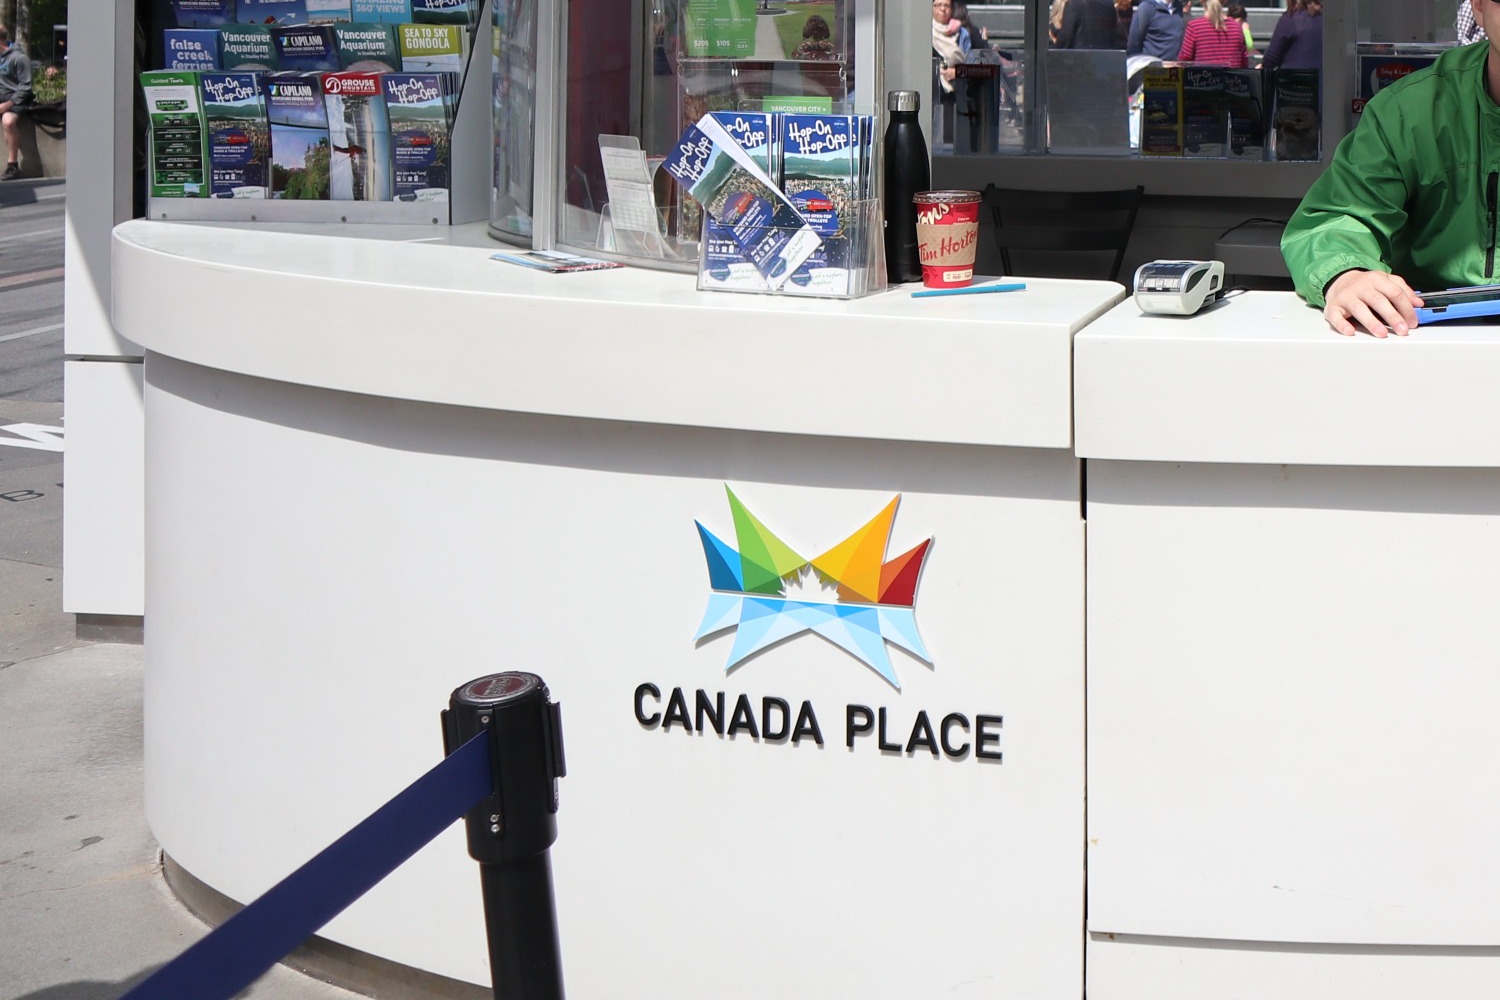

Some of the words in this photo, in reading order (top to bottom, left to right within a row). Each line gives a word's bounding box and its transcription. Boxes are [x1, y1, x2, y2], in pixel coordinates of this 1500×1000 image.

[376, 4, 405, 13] VIEWS
[222, 31, 271, 43] Vancouver
[336, 29, 386, 40] Vancouver
[404, 28, 420, 38] SEA
[421, 28, 432, 37] TO
[434, 28, 448, 37] SKY
[170, 38, 202, 51] false
[290, 35, 323, 46] CAPILANO
[340, 40, 385, 53] Aquarium
[406, 37, 450, 49] GONDOLA
[716, 39, 731, 48] $105
[223, 42, 269, 55] Aquarium
[176, 50, 213, 61] creek
[204, 77, 240, 94] Hop-On
[341, 79, 375, 87] GROUSE
[388, 77, 424, 95] Hop-On
[215, 86, 254, 103] Hop-Off
[280, 85, 312, 97] CAPILANO
[398, 87, 438, 105] Hop-Off
[788, 119, 832, 142] Hop-On
[799, 133, 848, 155] Hop-Off
[669, 140, 697, 179] Hop-On
[685, 136, 714, 183] Hop-Off
[917, 242, 938, 262] Tim
[633, 681, 824, 748] CANADA
[846, 703, 1004, 763] PLACE
